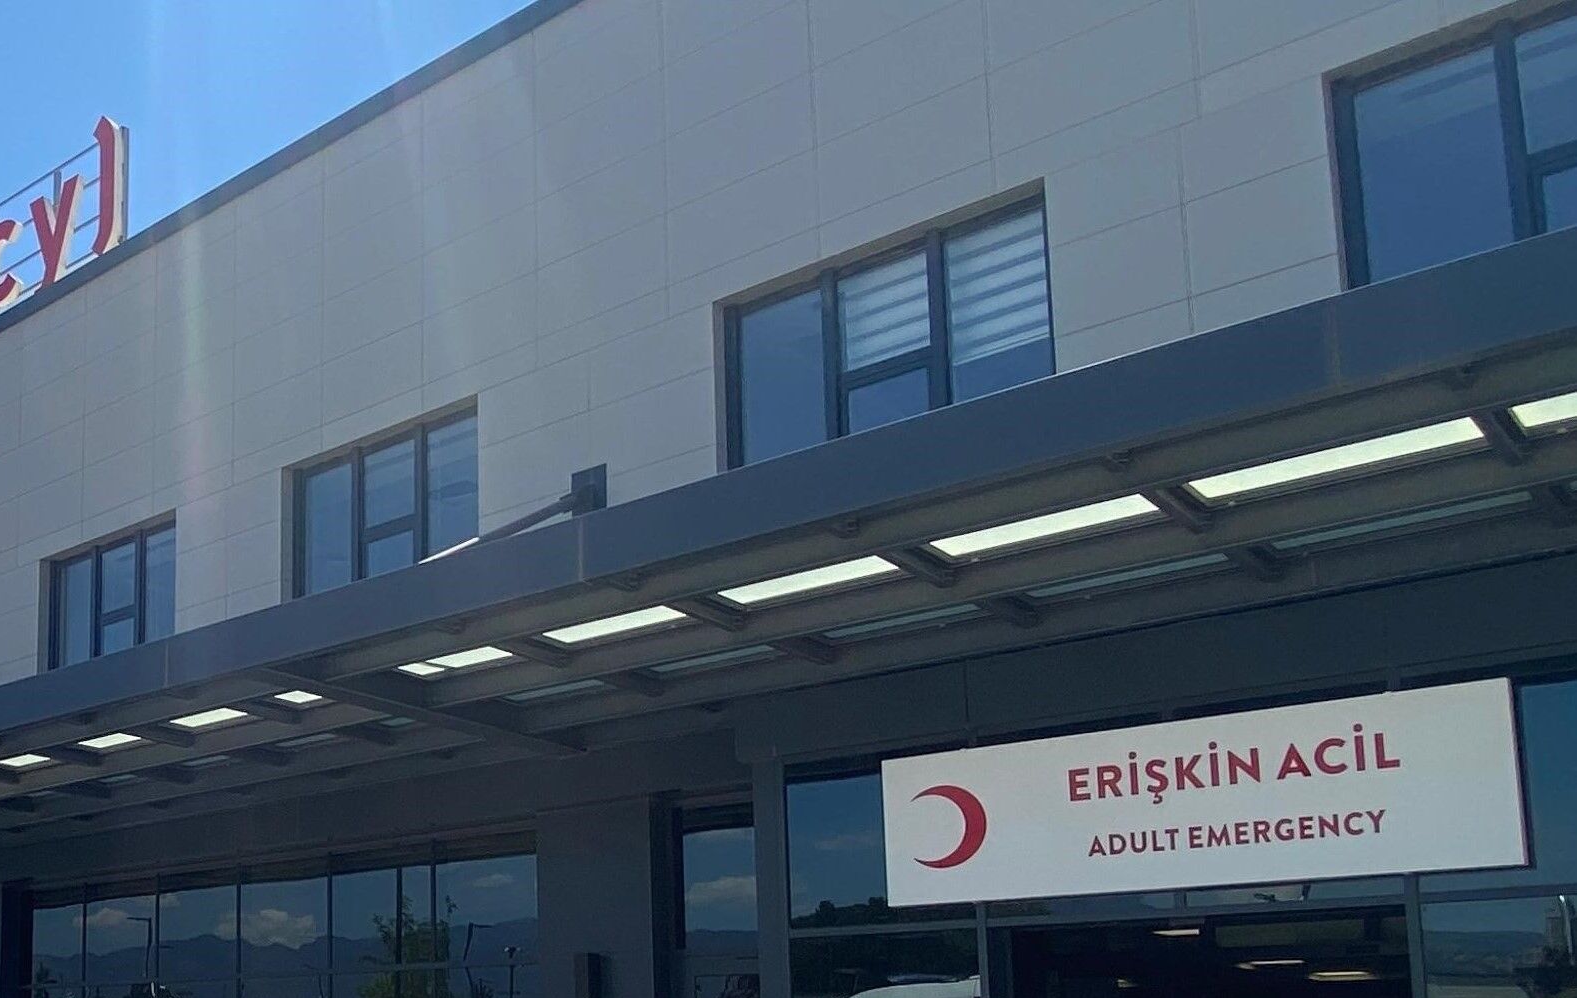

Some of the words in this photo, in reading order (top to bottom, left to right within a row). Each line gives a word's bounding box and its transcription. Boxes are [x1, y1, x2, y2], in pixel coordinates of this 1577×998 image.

[1067, 741, 1261, 804] ERİŞKİN
[1276, 723, 1401, 780] ACİL
[1088, 827, 1179, 858] ADULT
[1188, 808, 1387, 849] EMERGENCY
